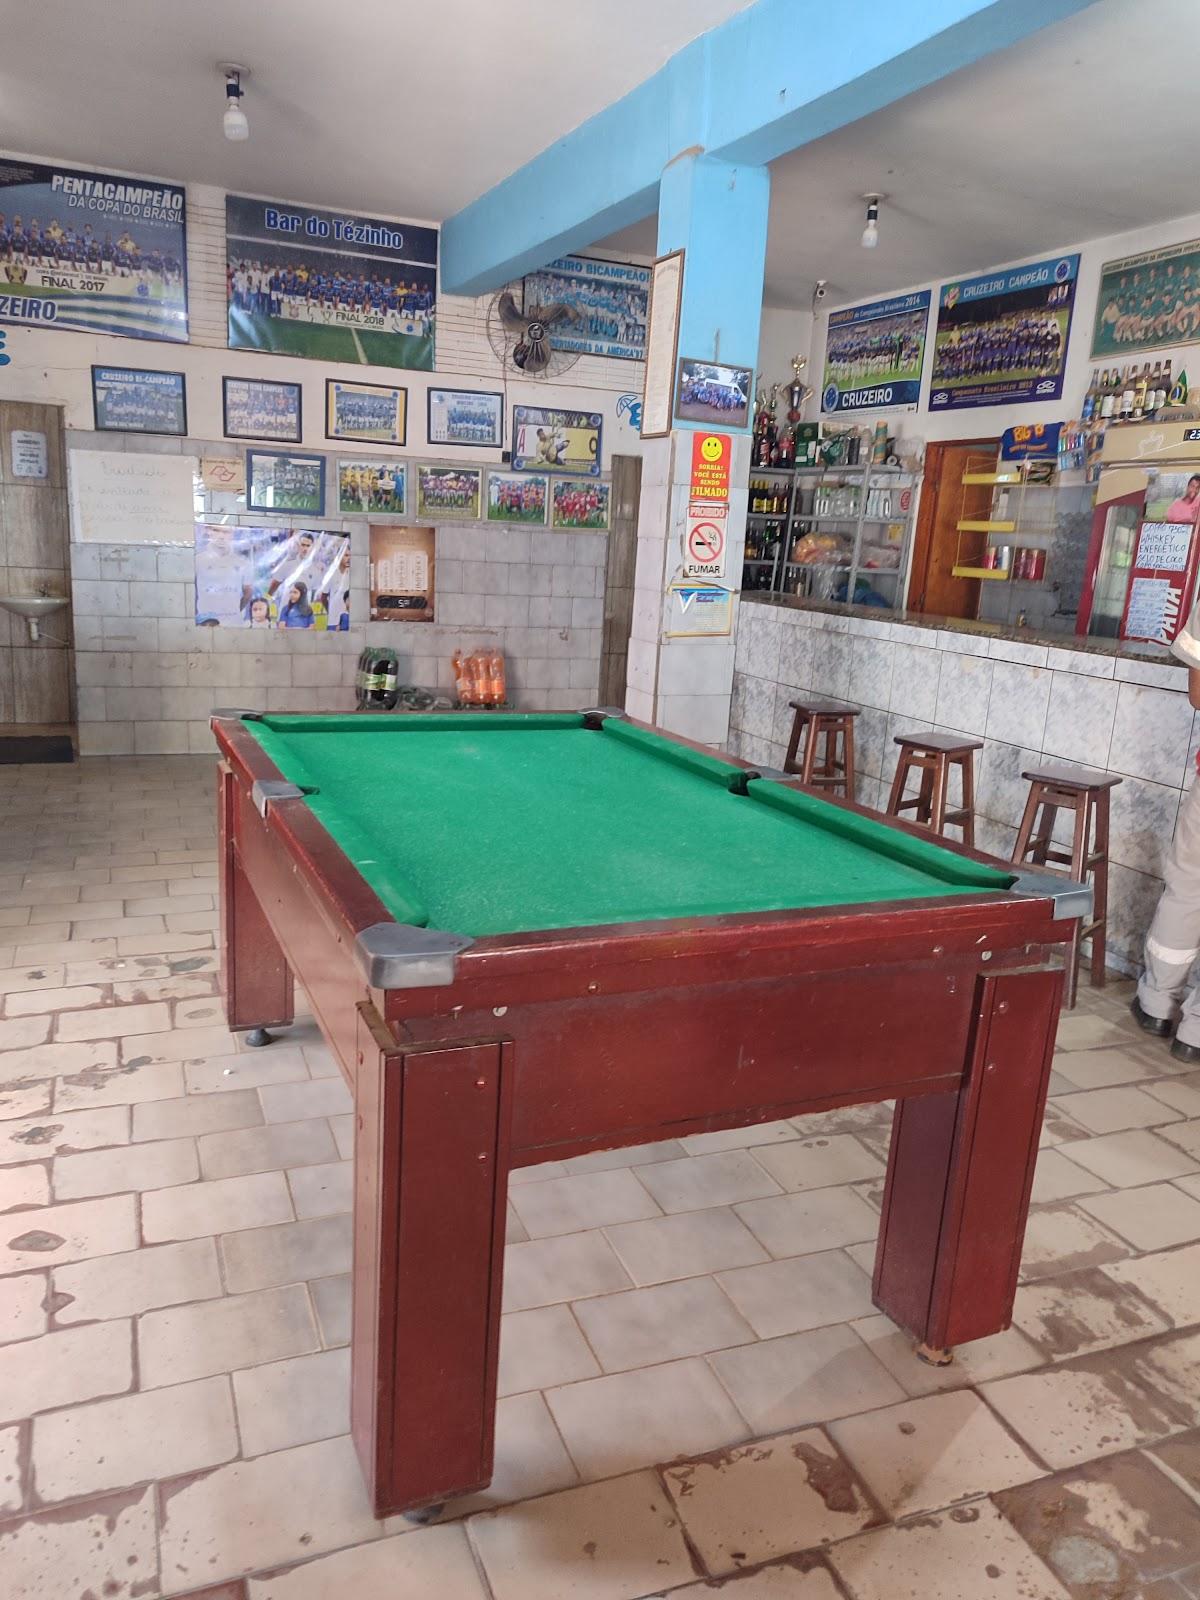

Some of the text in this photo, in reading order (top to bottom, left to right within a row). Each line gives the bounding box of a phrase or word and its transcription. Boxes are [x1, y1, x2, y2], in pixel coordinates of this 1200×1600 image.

[51, 174, 183, 210] PENTACAMPEÃO
[68, 196, 86, 209] DA
[88, 197, 120, 213] COPA
[124, 202, 140, 217] DO
[143, 206, 184, 224] BRASIL
[265, 207, 403, 249] Bar do Tézinho
[41, 275, 105, 291] FINAL 2017
[963, 268, 1049, 298] CRUZEIRO CAMPEÃO
[336, 312, 361, 322] FINAL
[364, 316, 385, 326] 2018
[842, 387, 893, 408] CRUZEIRO
[691, 486, 728, 497] FILMADO
[690, 506, 725, 517] PROIBIDO
[689, 564, 720, 574] FUMAR
